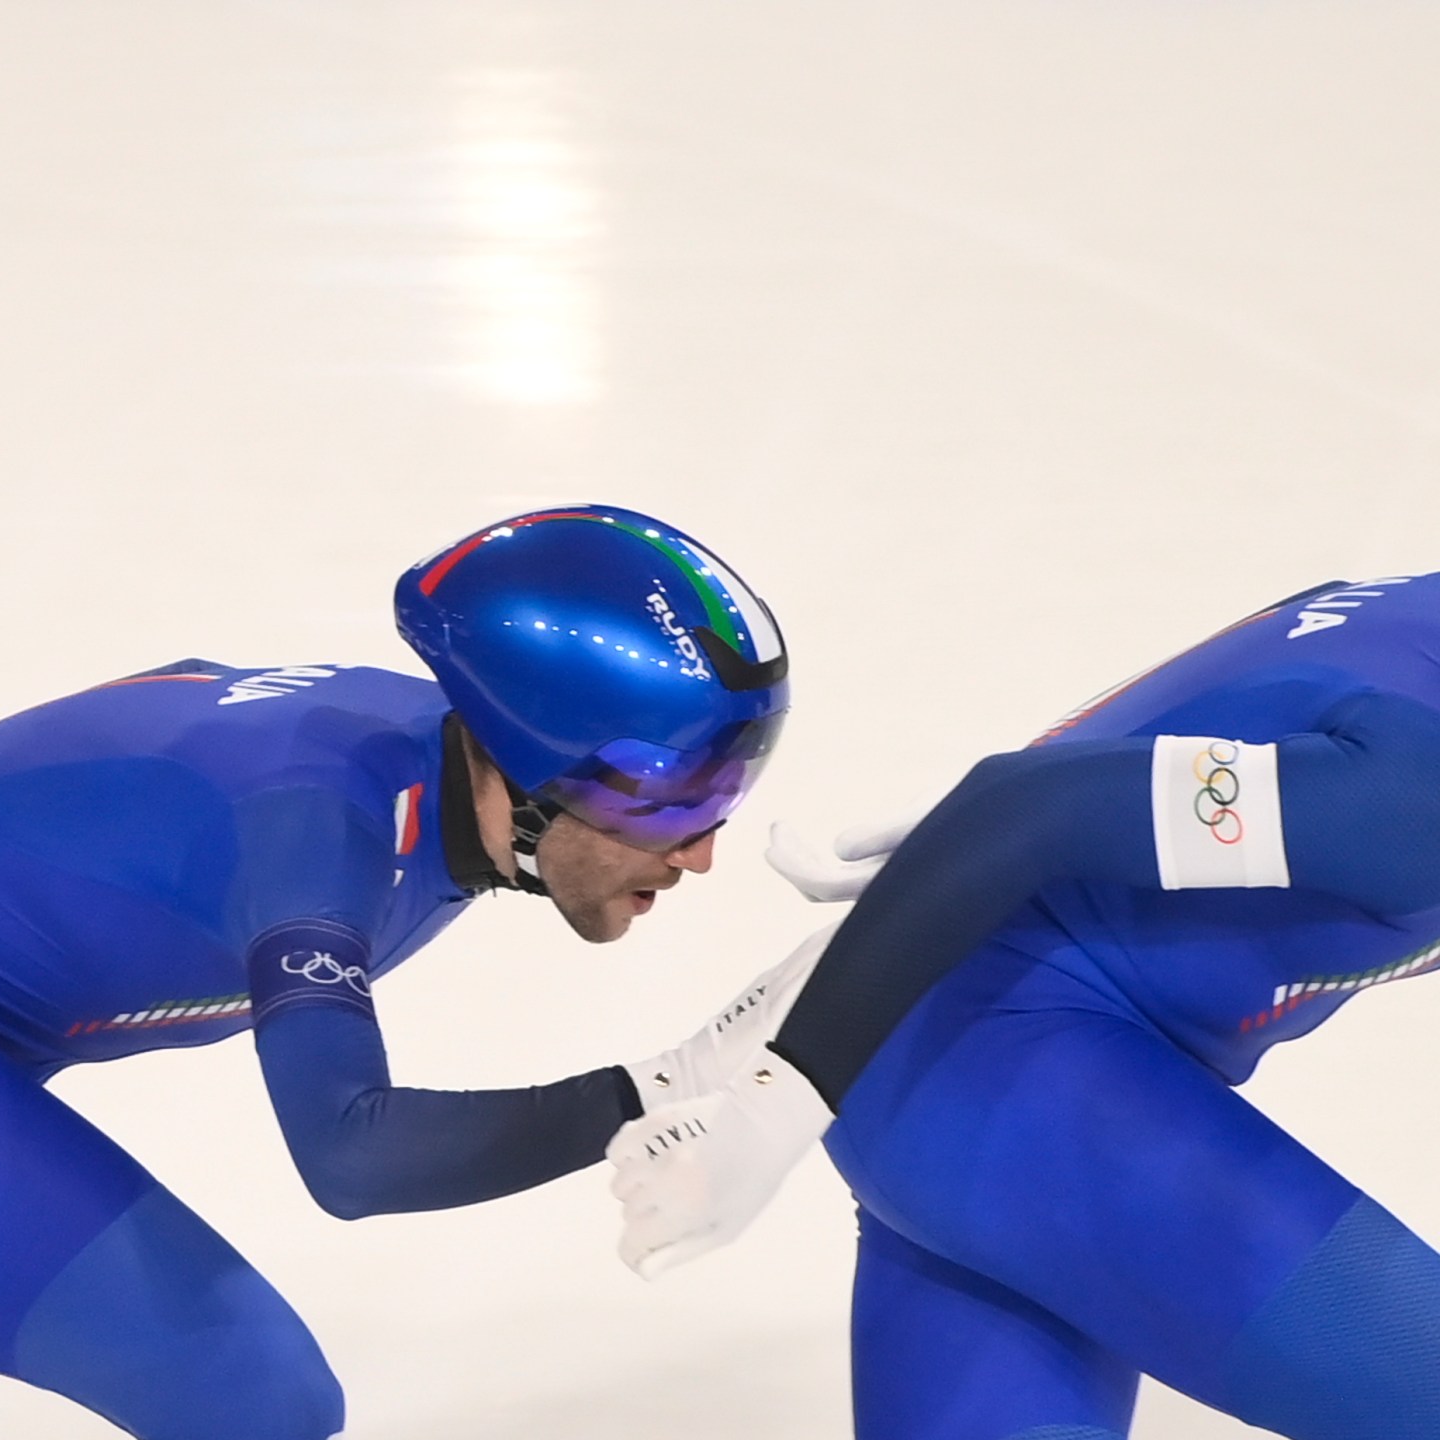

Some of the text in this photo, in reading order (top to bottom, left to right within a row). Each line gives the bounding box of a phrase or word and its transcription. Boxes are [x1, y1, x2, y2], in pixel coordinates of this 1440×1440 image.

[1287, 579, 1412, 640] LIA
[646, 592, 712, 679] RUDY
[217, 665, 338, 706] ALIA
[716, 985, 766, 1033] ITALY
[644, 1118, 708, 1160] ITALY
